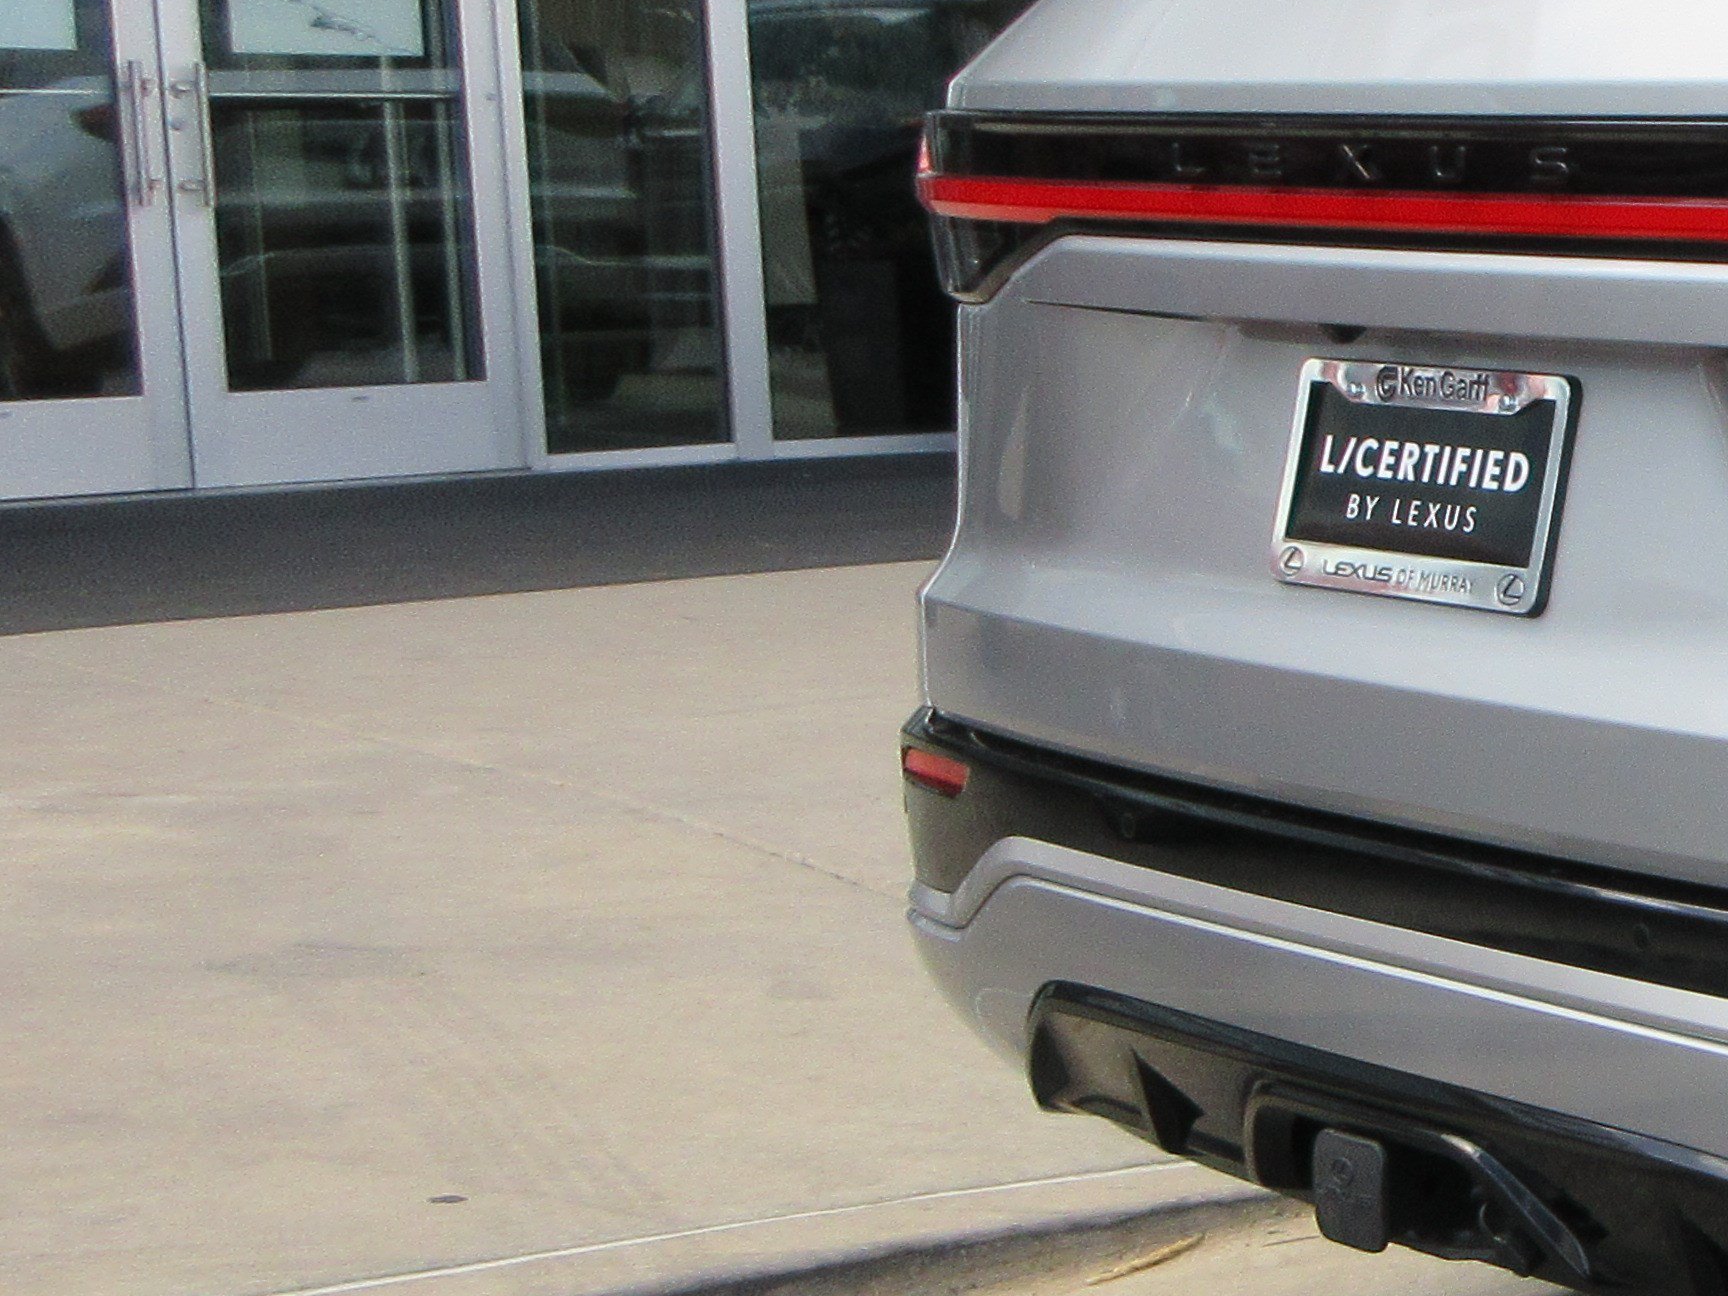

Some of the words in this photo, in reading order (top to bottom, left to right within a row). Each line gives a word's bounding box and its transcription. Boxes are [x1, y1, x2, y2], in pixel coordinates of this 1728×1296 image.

[1170, 140, 1571, 183] LEXUS
[1400, 367, 1437, 397] Ken
[1319, 434, 1530, 492] L/CERTIFIED
[1346, 493, 1380, 520] BY
[1391, 498, 1478, 533] LEXUS
[1322, 558, 1393, 583] LEXUS
[1396, 568, 1415, 587] OF
[1418, 568, 1474, 595] MURRAY
